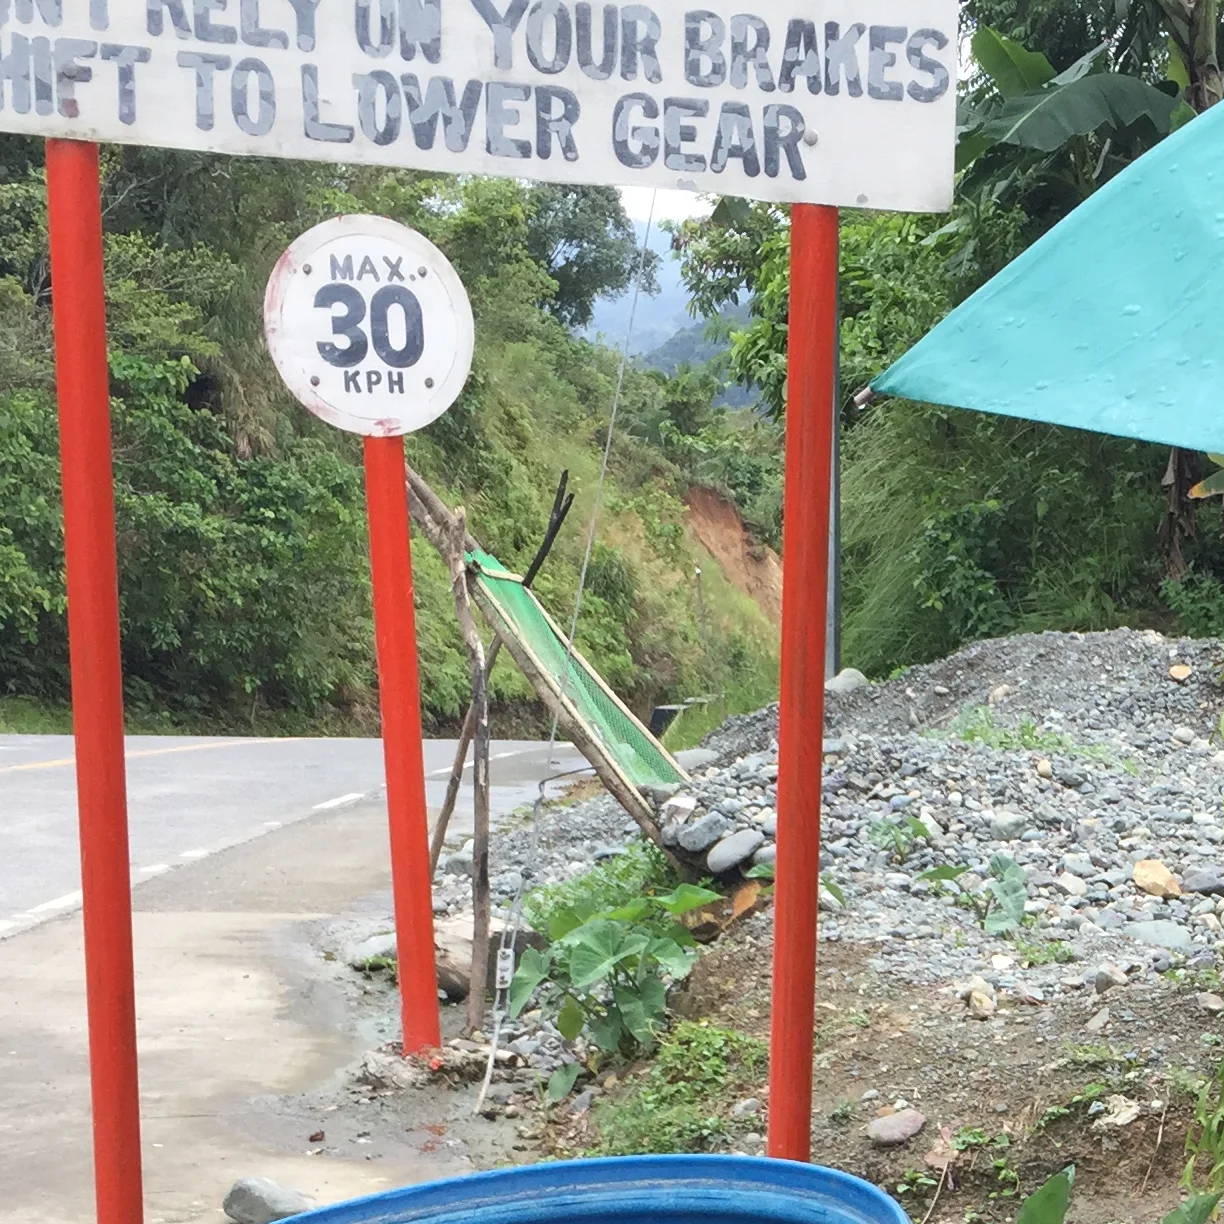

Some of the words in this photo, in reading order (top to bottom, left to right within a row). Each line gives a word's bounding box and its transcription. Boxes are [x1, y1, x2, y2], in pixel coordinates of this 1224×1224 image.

[355, 0, 441, 64] ON
[469, 0, 663, 84] YOUR
[684, 10, 950, 103] BRAKES
[176, 51, 277, 136] TO
[301, 63, 581, 162] LOWER
[612, 92, 807, 181] GEAR
[329, 253, 416, 282] MAX.
[313, 282, 424, 368] 30
[343, 369, 405, 394] KPH
